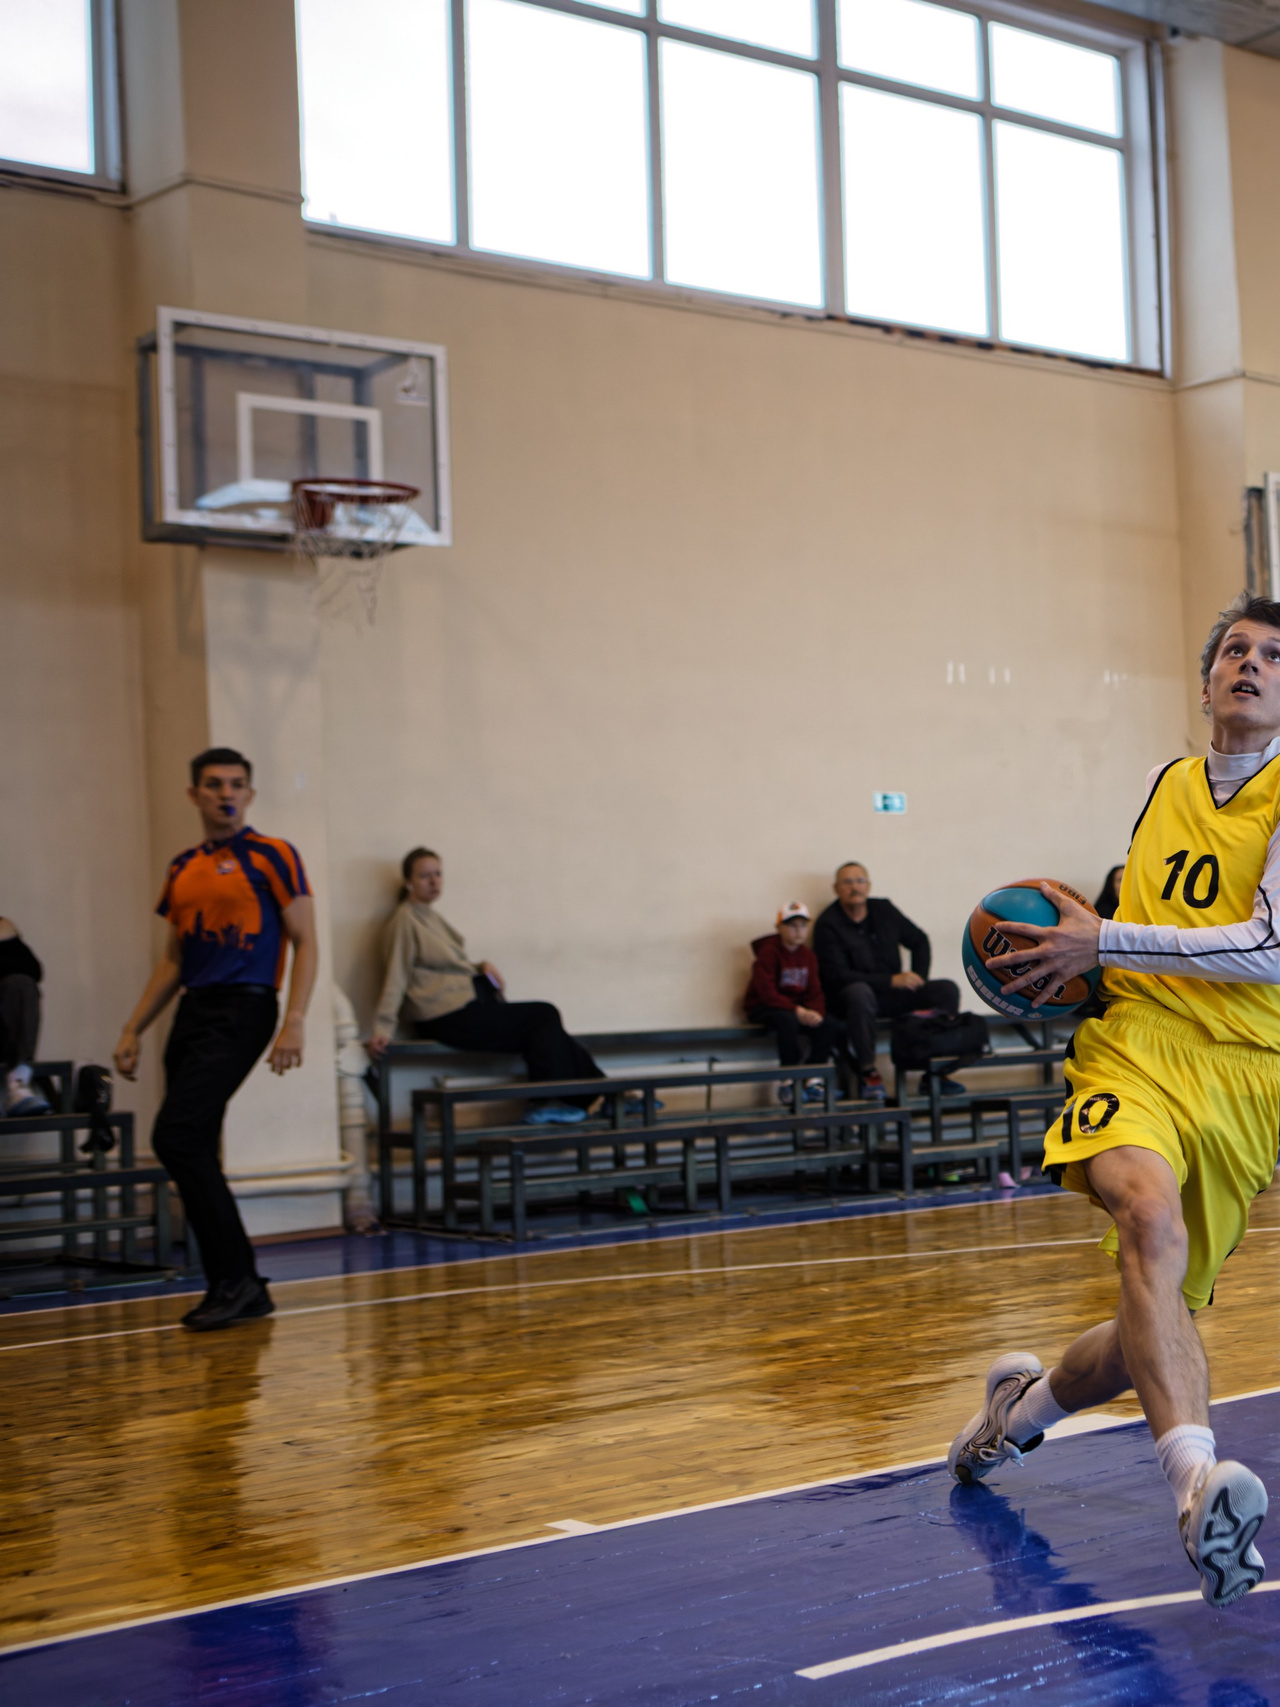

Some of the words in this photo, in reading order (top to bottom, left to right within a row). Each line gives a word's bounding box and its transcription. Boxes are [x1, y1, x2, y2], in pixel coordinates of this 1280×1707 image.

[1161, 850, 1219, 908] 10
[966, 965, 1024, 1016] SIBUR
[1062, 1093, 1120, 1144] 10
